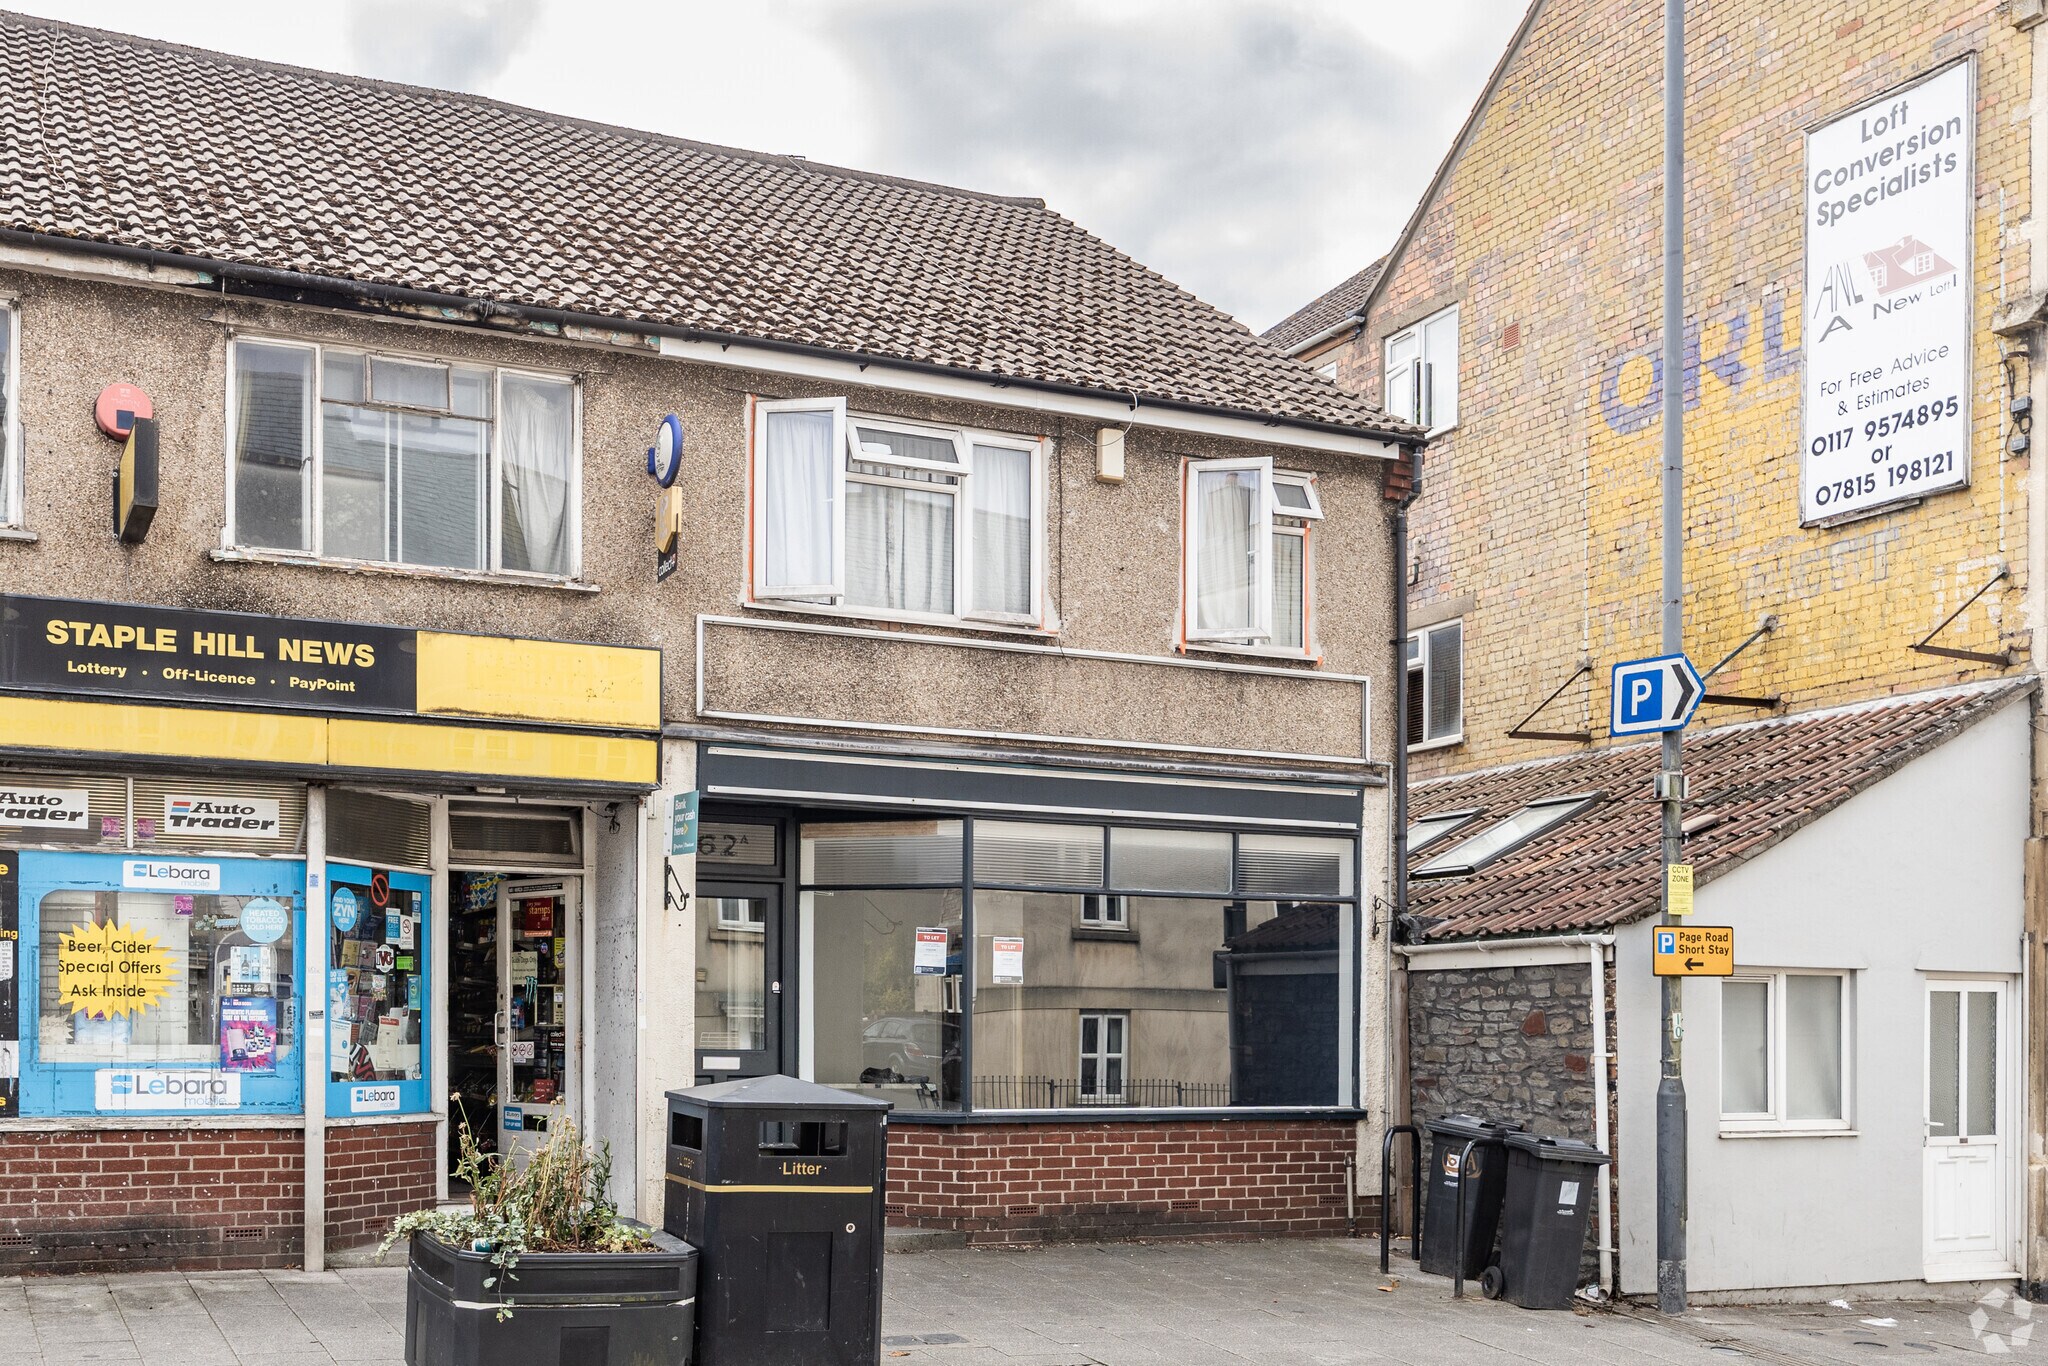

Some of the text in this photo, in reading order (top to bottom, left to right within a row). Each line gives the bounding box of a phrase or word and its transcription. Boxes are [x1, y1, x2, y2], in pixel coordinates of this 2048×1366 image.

[1861, 100, 1908, 143] Loft
[1813, 116, 1961, 194] Conversion
[1816, 152, 1957, 227] Specialists
[1873, 291, 1922, 320] New
[1820, 345, 1949, 397] For Free Advice
[1837, 377, 1930, 416] & Estimates
[1811, 395, 1959, 457] 0117 9574895
[1871, 444, 1892, 464] or
[1815, 451, 1953, 506] 07815 198121
[46, 619, 375, 668] STAPLE HILL NEWS
[67, 660, 356, 692] Lottery Off-Licence PayPoint
[1631, 678, 1652, 716] P
[0, 792, 63, 806] Auto
[0, 808, 84, 822] ader
[190, 801, 256, 816] Auto
[169, 814, 275, 831] Trader
[149, 864, 210, 880] Lebara
[181, 879, 210, 888] mobile
[334, 903, 355, 918] ZYN
[528, 907, 551, 917] stamps
[1661, 933, 1673, 952] P
[1679, 931, 1729, 944] Page Road
[68, 940, 152, 954] Beer, Cider
[1678, 944, 1730, 956] Short Stay
[58, 959, 162, 975] Special Offers
[70, 984, 147, 998] Ask Inside
[136, 1076, 227, 1096] Lebara
[186, 1095, 227, 1107] mobile
[363, 1089, 395, 1102] Lebara
[782, 1162, 822, 1175] Litter
